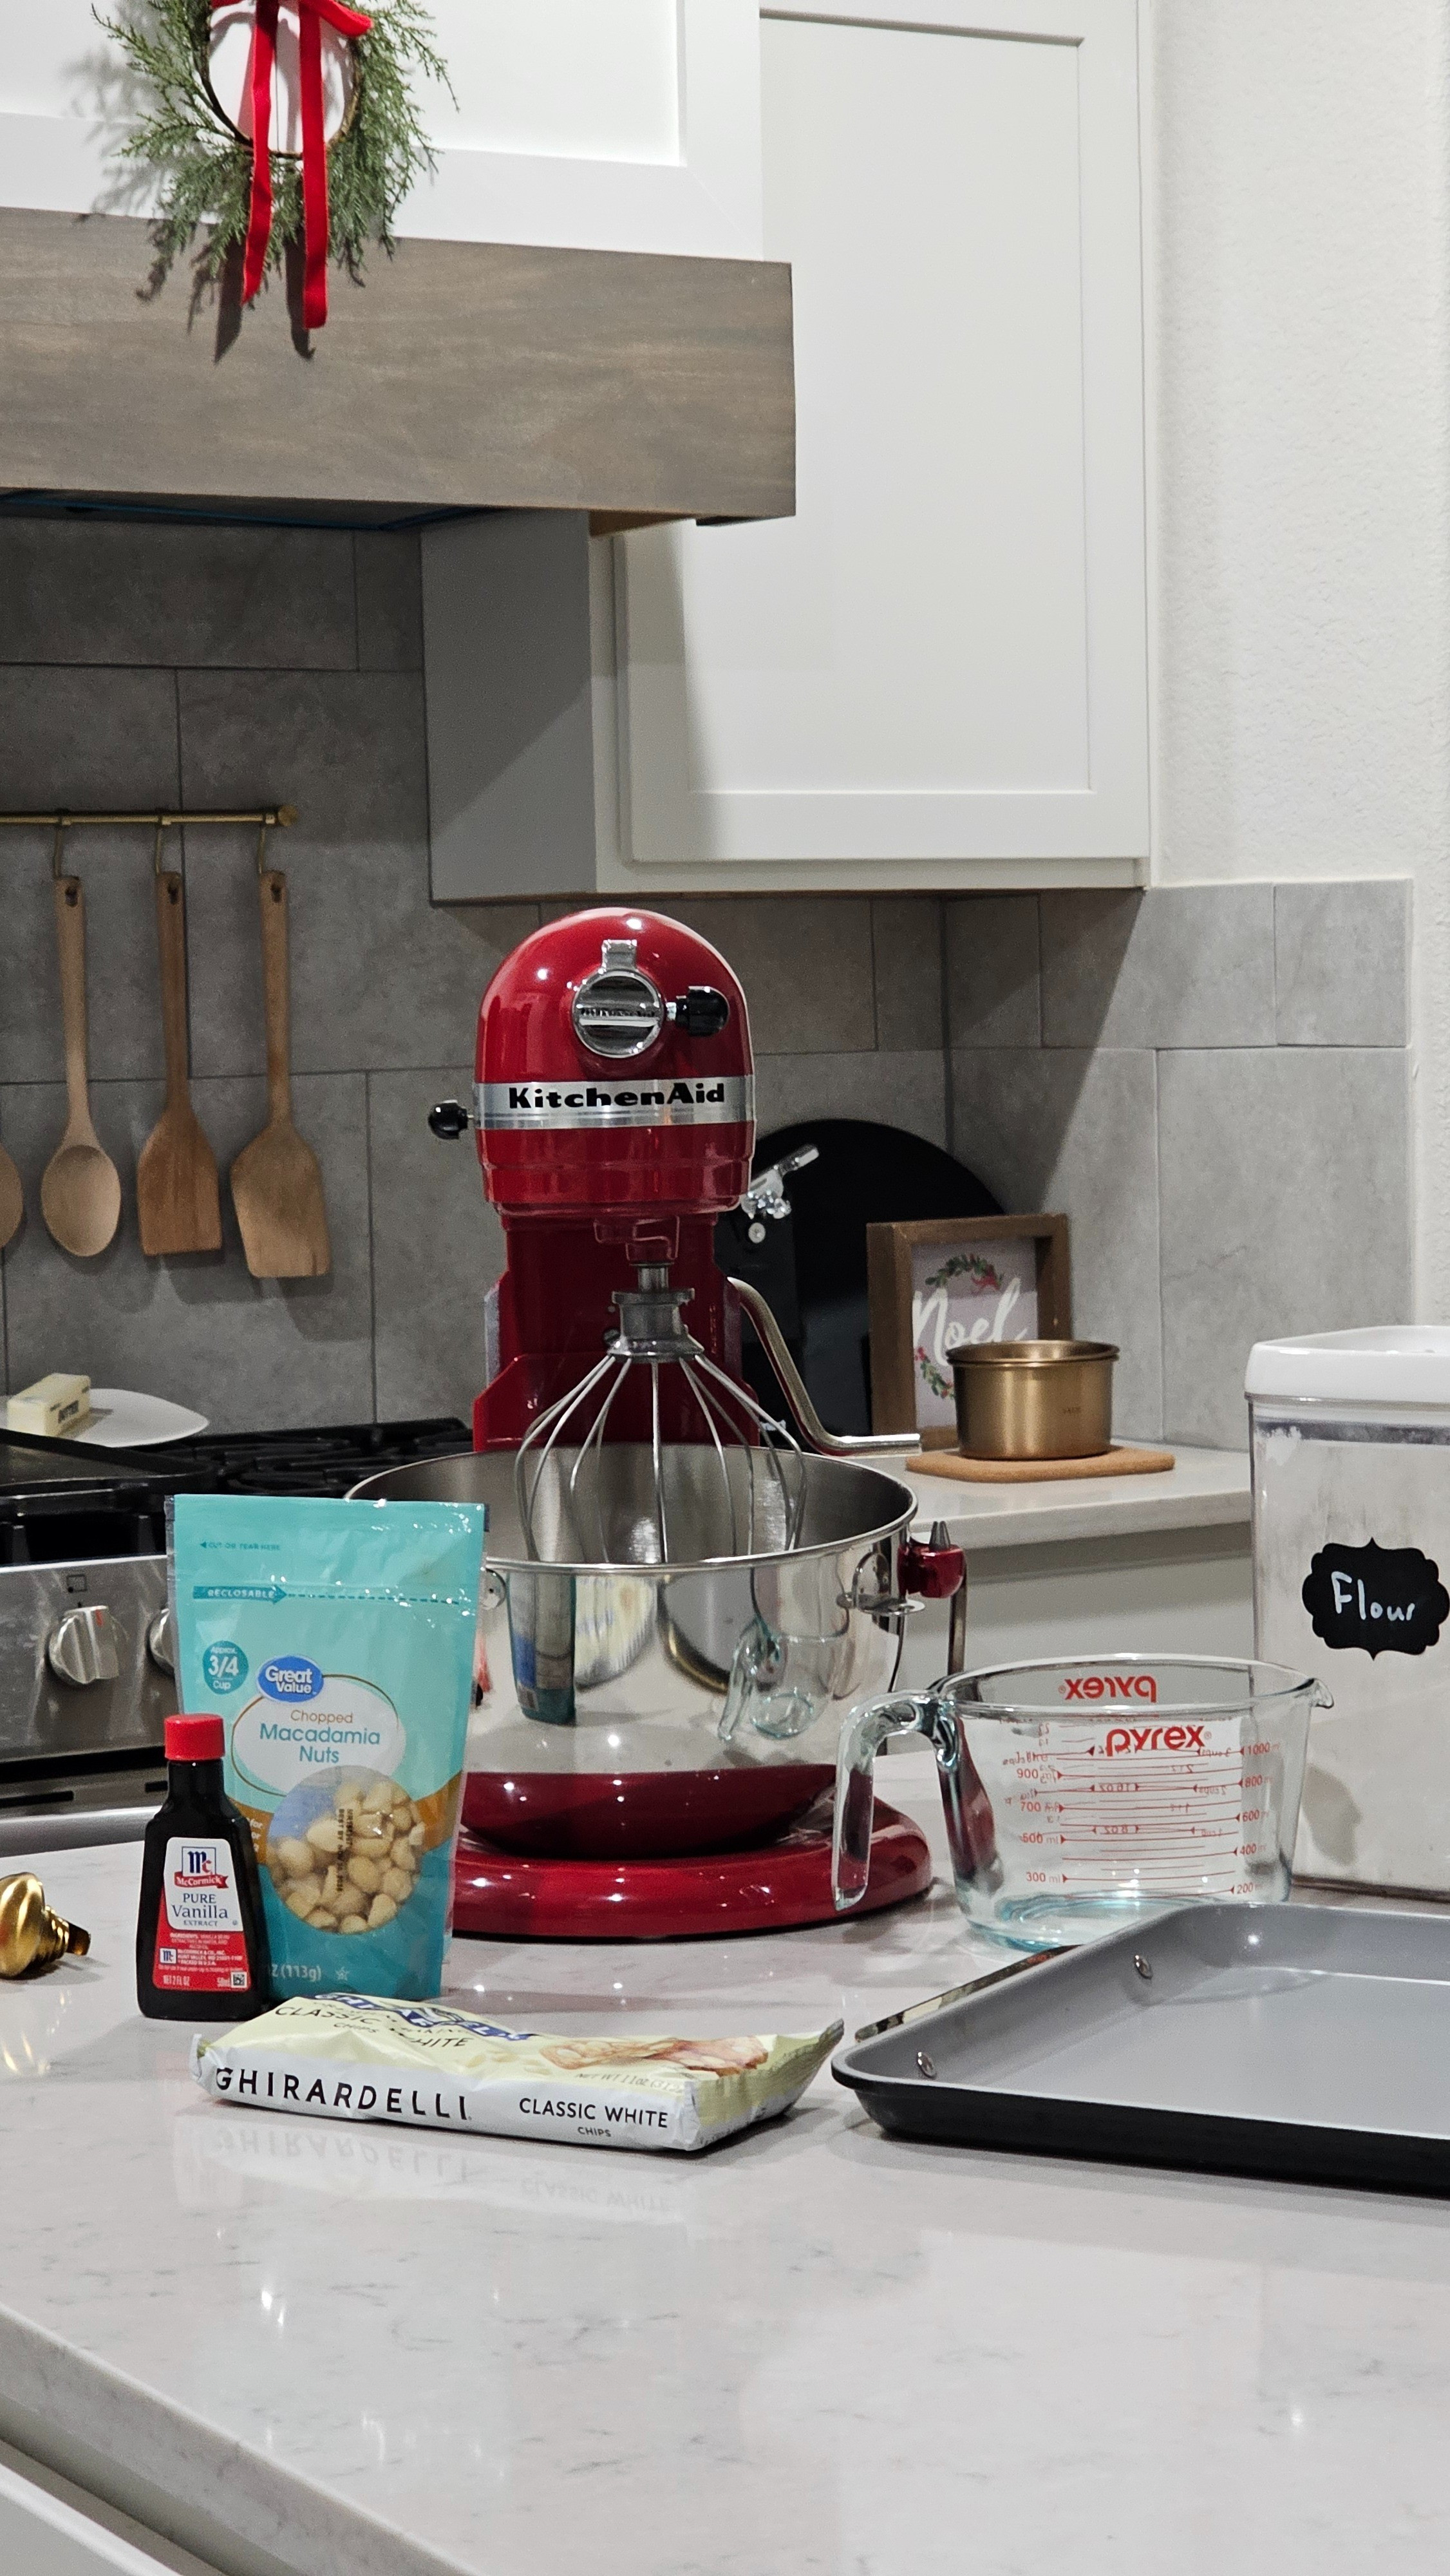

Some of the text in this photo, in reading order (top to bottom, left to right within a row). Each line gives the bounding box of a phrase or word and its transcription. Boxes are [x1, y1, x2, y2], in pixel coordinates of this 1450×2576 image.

[509, 1083, 724, 1109] KitchenAid
[912, 1278, 1028, 1367] Noel
[207, 1588, 275, 1598] RECLOSABLE
[1331, 1571, 1415, 1622] Flour
[208, 1655, 239, 1678] 3/4
[265, 1665, 313, 1683] Great
[212, 1680, 232, 1691] Cup
[275, 1680, 312, 1694] Value
[290, 1709, 353, 1724] Chopped
[259, 1723, 381, 1745] Macadamia
[1106, 1725, 1205, 1757] pyrex
[299, 1745, 339, 1763] Nuts
[1247, 1742, 1270, 1755] 1000
[1017, 1768, 1039, 1779] 900
[1245, 1775, 1263, 1788] 800
[1021, 1801, 1041, 1812] 700
[1242, 1810, 1260, 1822] 600
[1240, 1844, 1256, 1855] 400
[176, 1876, 221, 1887] McCormick
[1026, 1871, 1060, 1884] 300 ml
[1237, 1882, 1254, 1895] 200
[183, 1893, 216, 1904] PURE
[172, 1904, 228, 1919] Vanilla
[275, 2006, 381, 2025] CLASSIC
[216, 2067, 467, 2121] GHIRARDELLI
[519, 2098, 668, 2128] CLASSIC WHITE
[578, 2127, 611, 2137] CHIPS
